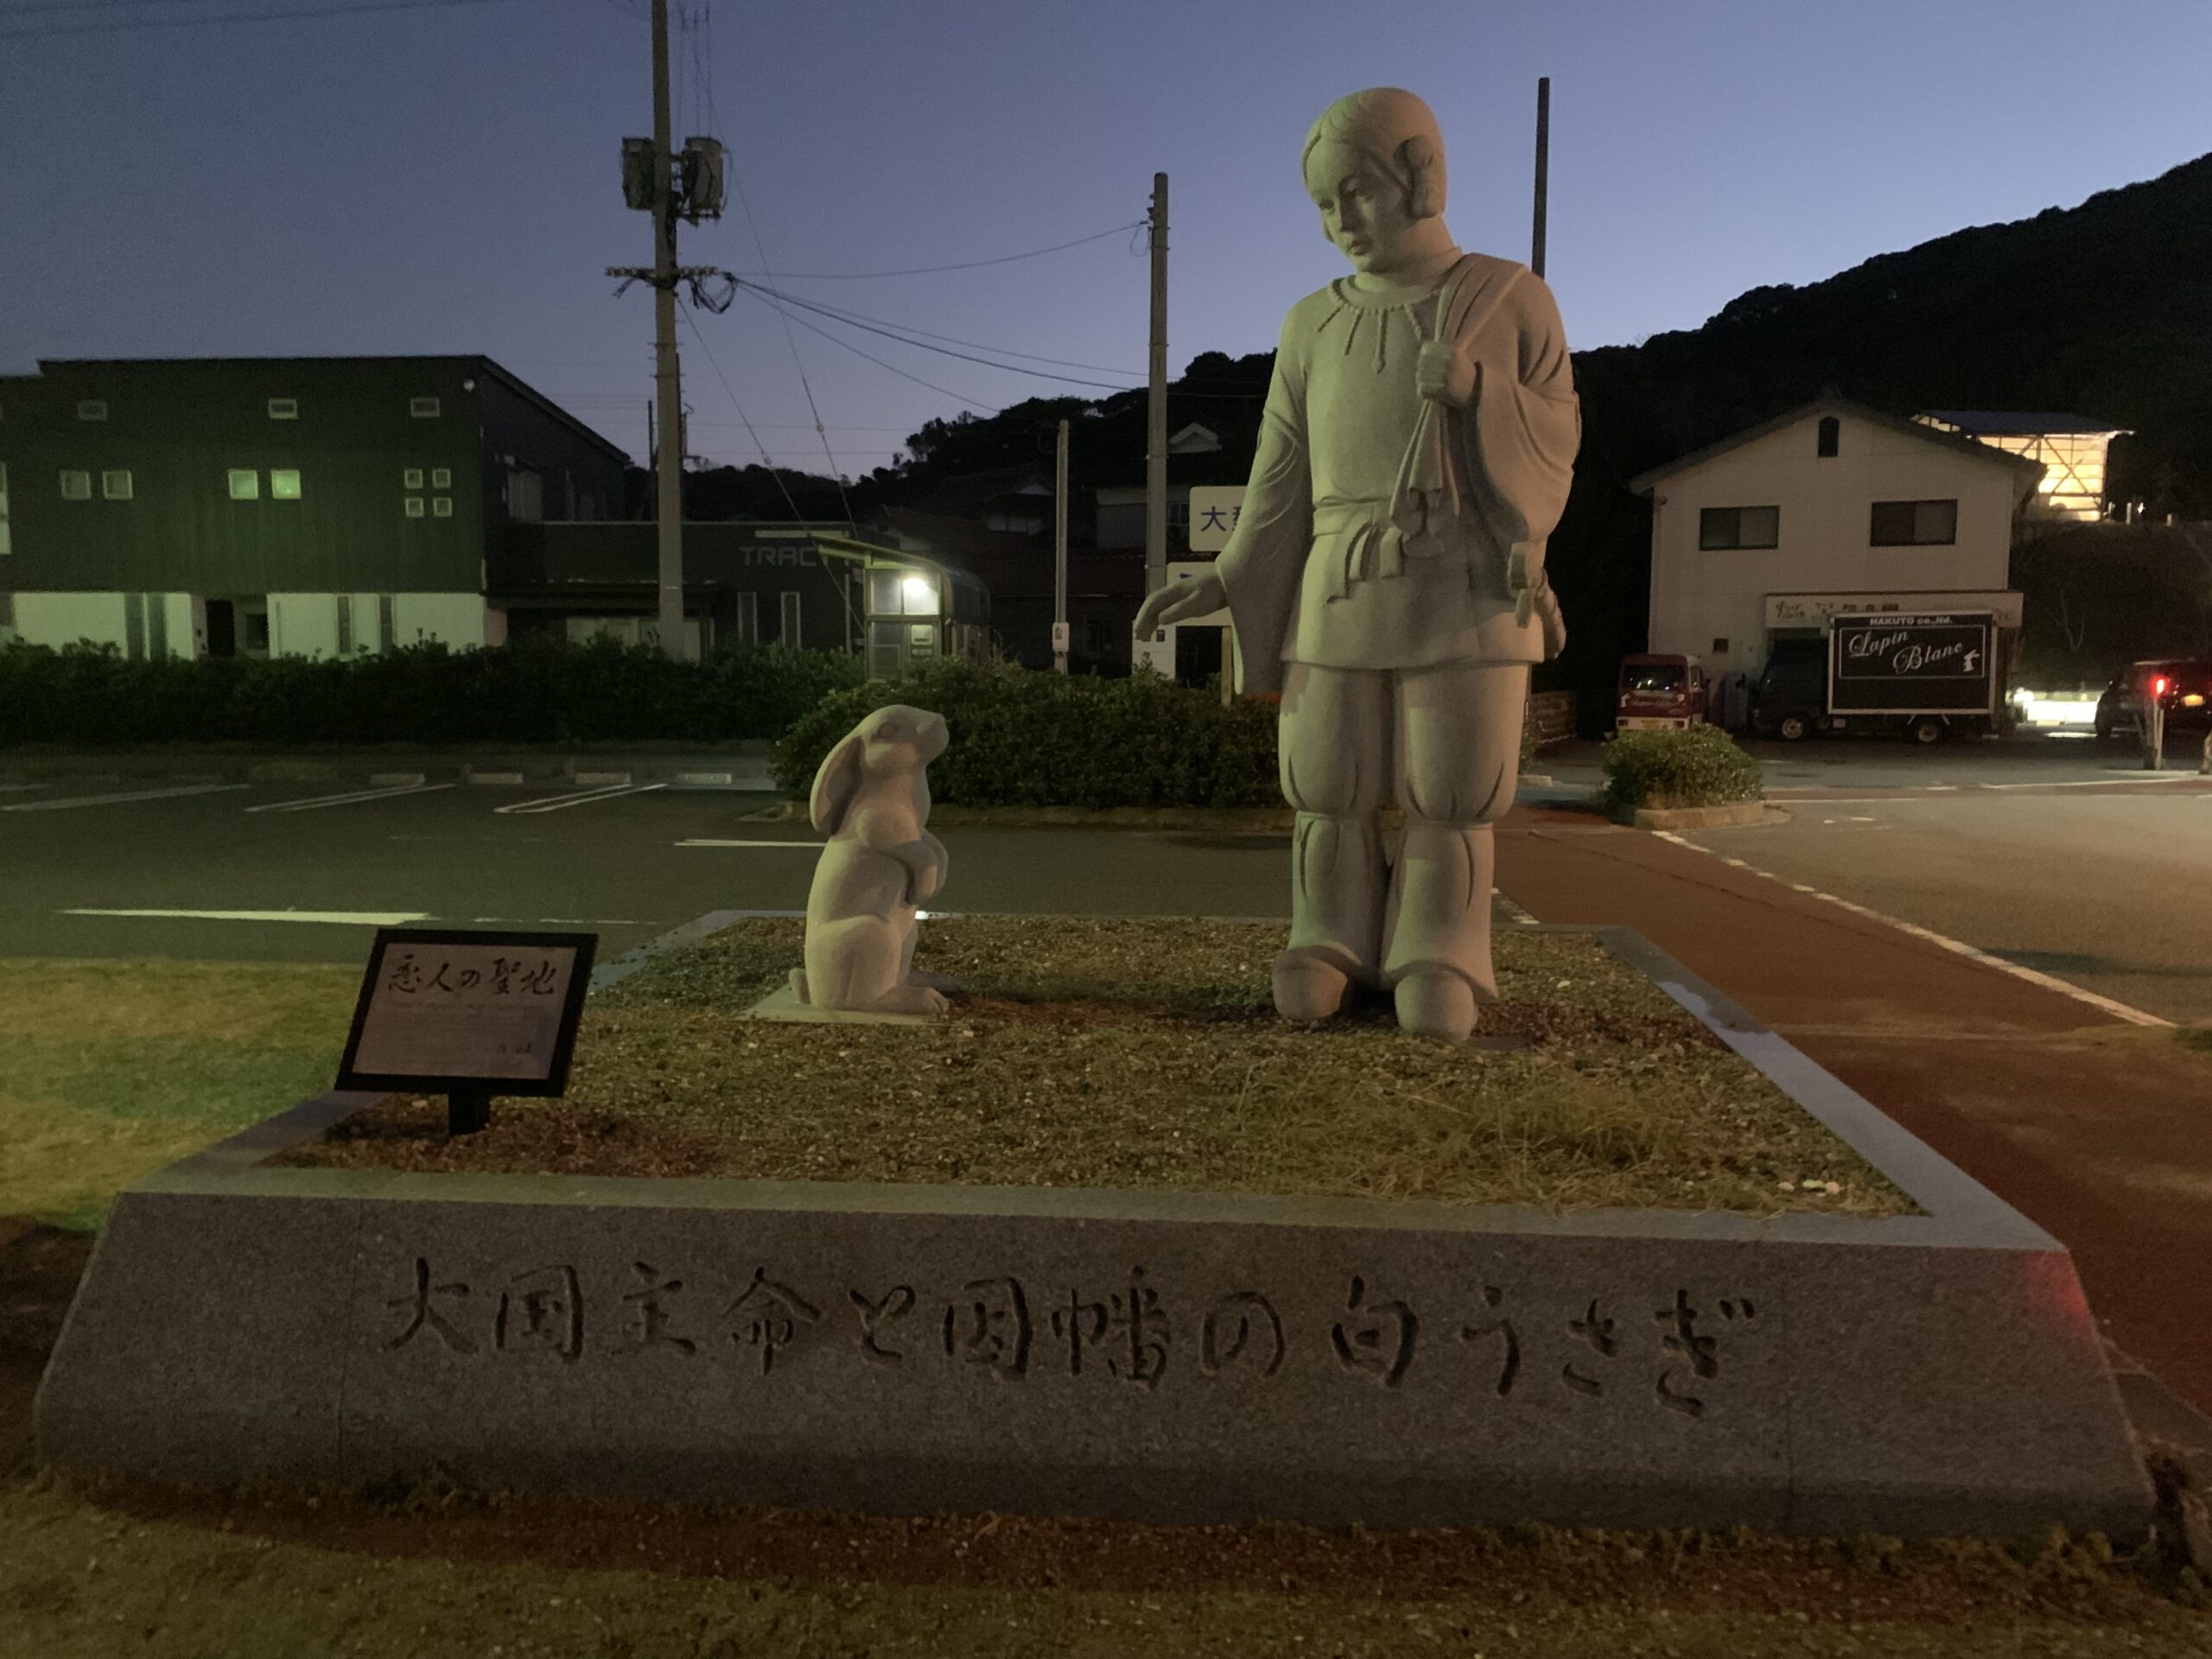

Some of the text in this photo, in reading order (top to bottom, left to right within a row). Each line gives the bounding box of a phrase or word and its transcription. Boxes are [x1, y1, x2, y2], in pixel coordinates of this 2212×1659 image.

[1870, 617, 1915, 626] HAKUTO
[1848, 630, 1909, 658] Lapin
[1892, 642, 1963, 675] Blanc
[388, 953, 556, 995] 恋人の聖地
